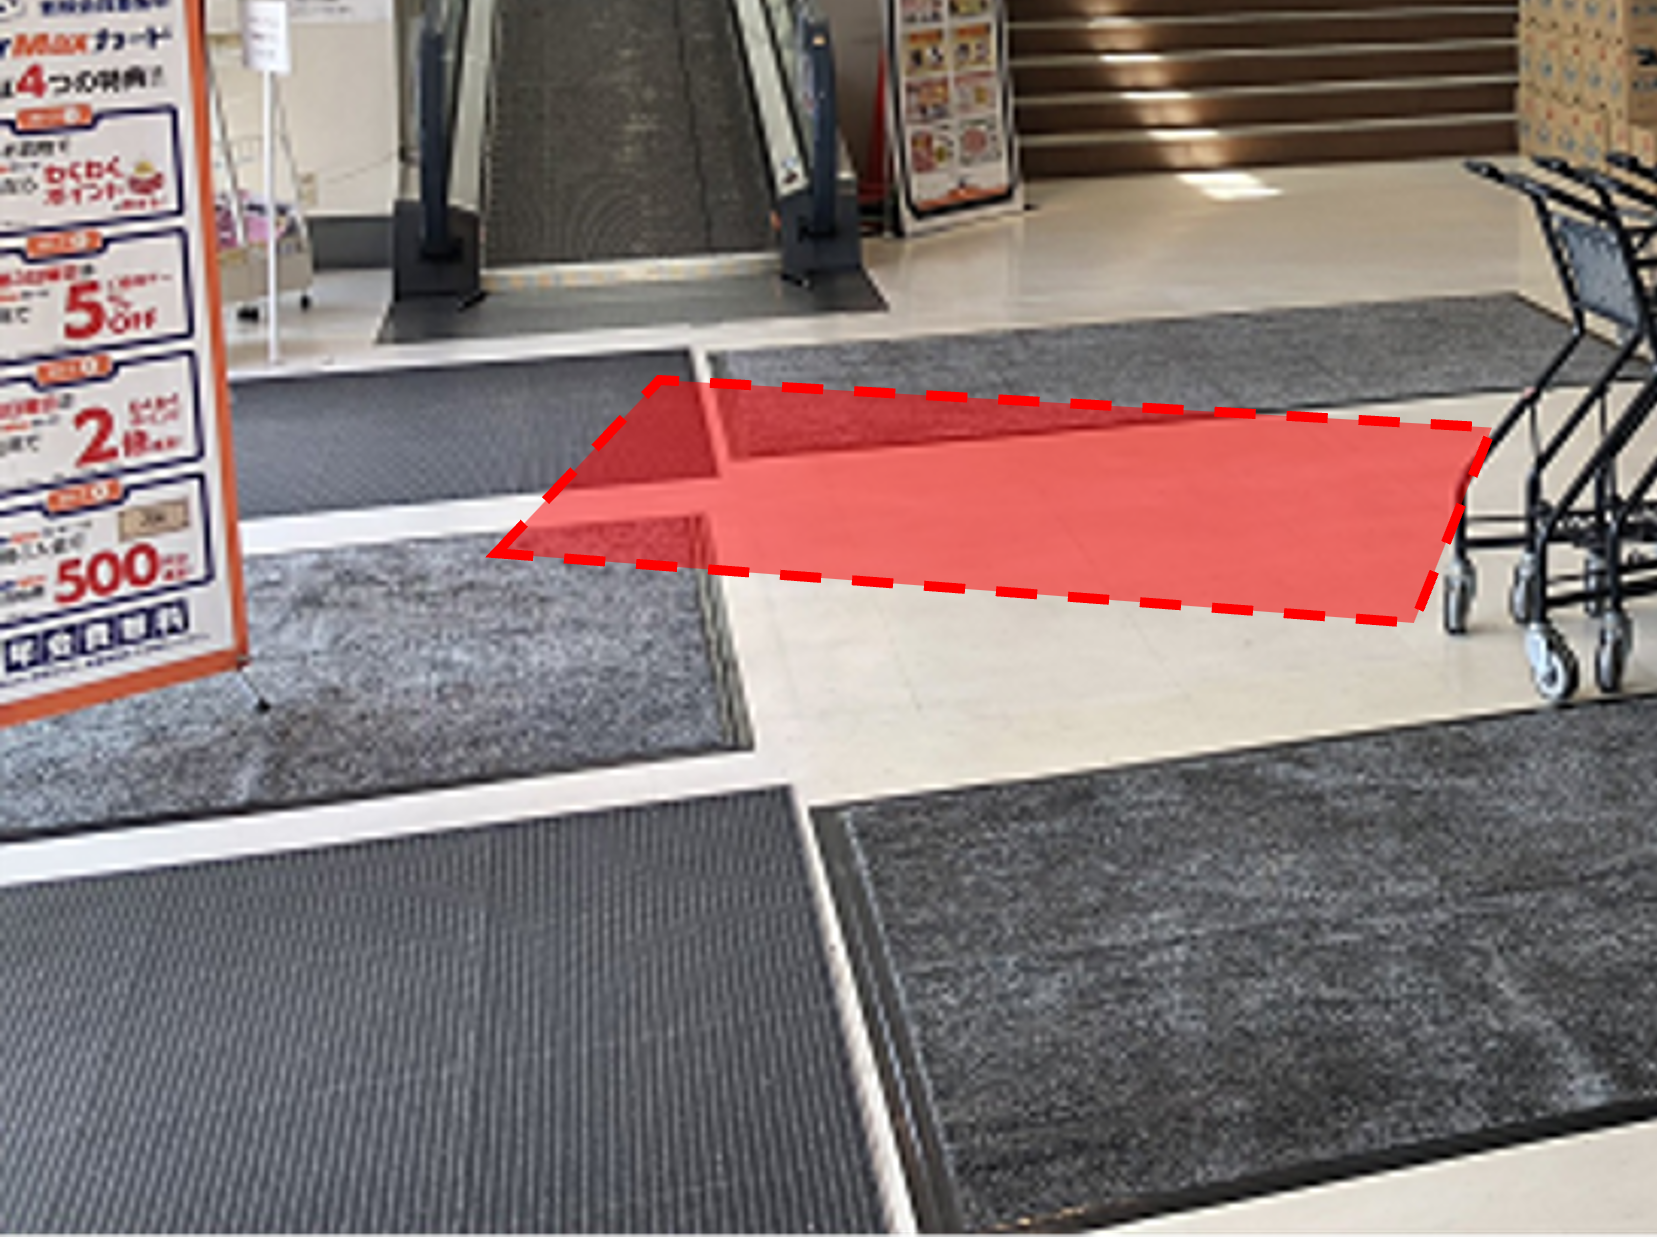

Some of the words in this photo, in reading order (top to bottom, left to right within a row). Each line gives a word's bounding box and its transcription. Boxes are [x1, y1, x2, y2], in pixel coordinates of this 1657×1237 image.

[64, 280, 104, 339] 5
[74, 407, 119, 468] 2
[54, 542, 158, 604] 500
